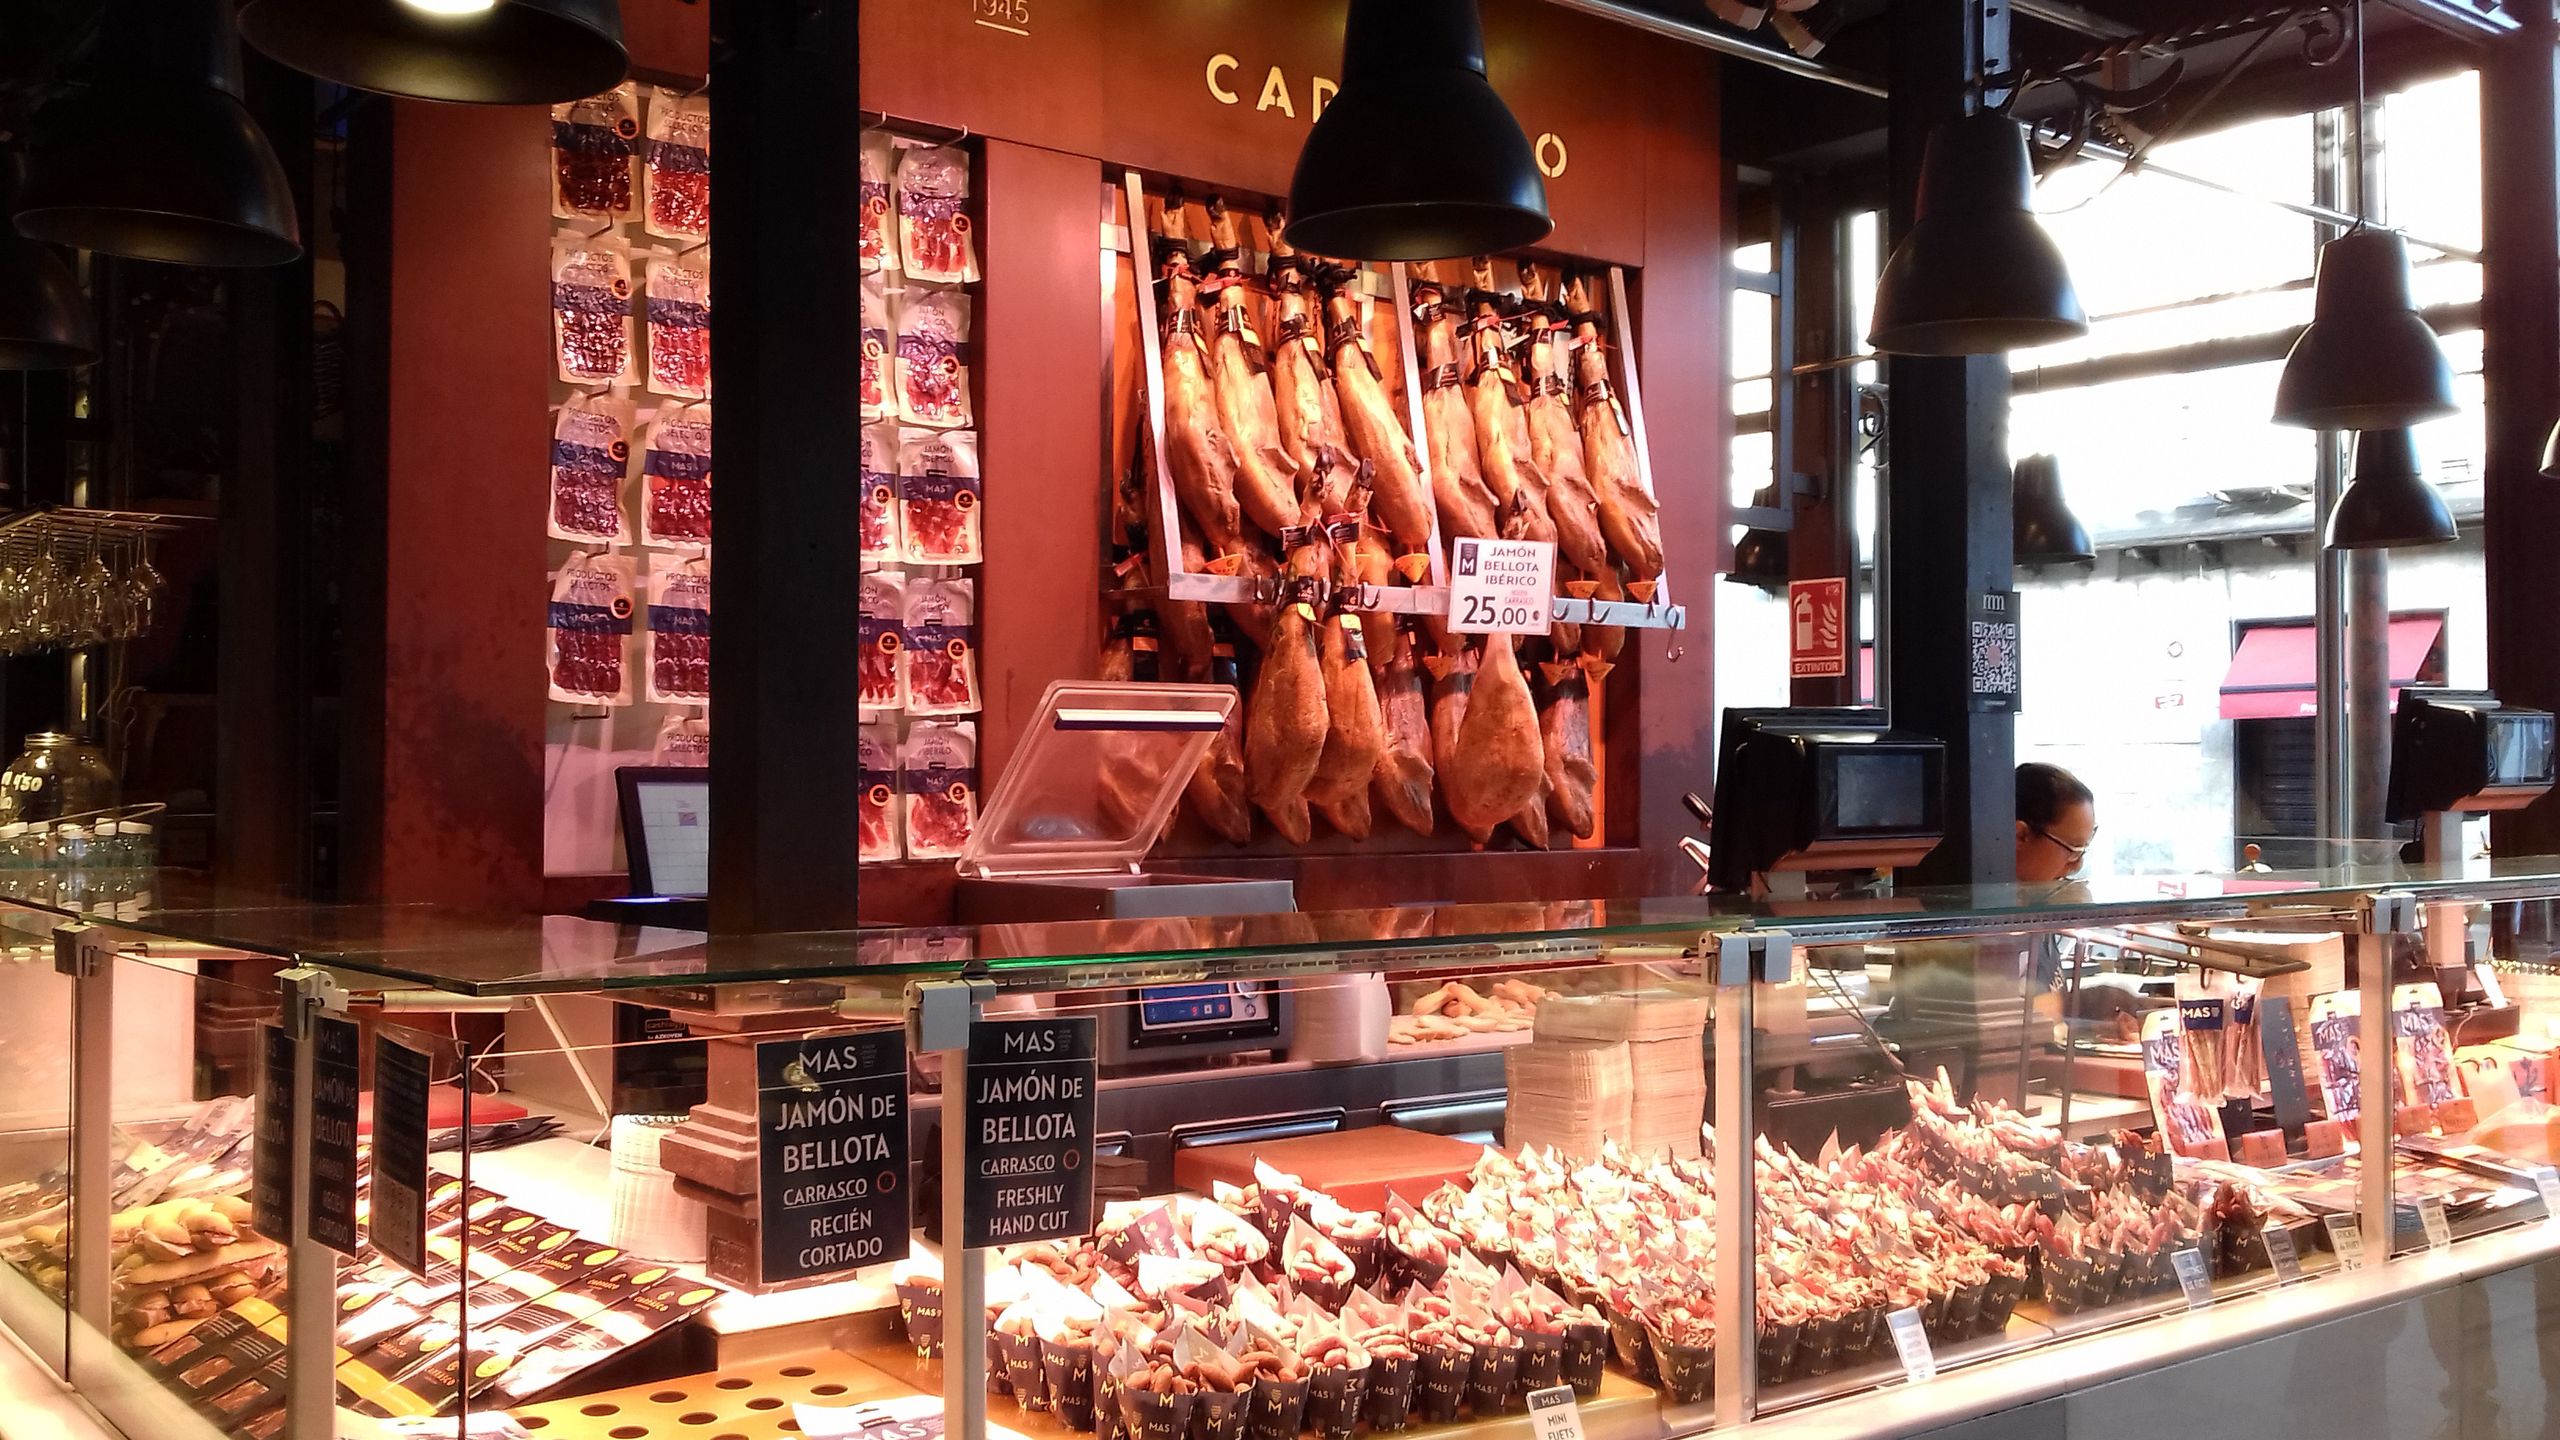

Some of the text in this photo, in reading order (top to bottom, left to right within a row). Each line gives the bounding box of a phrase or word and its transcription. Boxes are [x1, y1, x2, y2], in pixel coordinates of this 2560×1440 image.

[1490, 546, 1536, 557] JAMÓN
[1484, 561, 1539, 572] BELLOTA
[1486, 573, 1537, 586] IBÉRICO
[1461, 595, 1527, 627] 25,00
[859, 626, 869, 634] AS
[1795, 662, 1838, 672] EXTINTOR
[668, 733, 709, 743] PRODUCTO
[926, 777, 944, 785] MAS
[2181, 1008, 2211, 1018] MAS
[1004, 1029, 1056, 1053] MAS
[2318, 1024, 2342, 1045] MAS
[321, 1031, 342, 1053] MAS
[799, 1046, 858, 1074] MAS
[977, 1070, 1083, 1104] JAMÓN DE
[775, 1089, 897, 1131] JAMÓN DE
[982, 1112, 1076, 1144] BELLOTA
[783, 1133, 891, 1173] BELLOTA
[2145, 1151, 2156, 1160] M
[981, 1153, 1056, 1176] CARRASCO
[2138, 1167, 2153, 1176] MAS
[1982, 1179, 1993, 1190] M
[2041, 1173, 2052, 1183] M
[783, 1178, 868, 1206] CARRASCO
[997, 1185, 1064, 1208] FRESHLY
[810, 1208, 872, 1238] RECIÉN
[990, 1211, 1069, 1236] HAND CUT
[1115, 1231, 1129, 1248] M
[799, 1236, 883, 1269] CORTADO
[1343, 1245, 1362, 1254] MAS
[2093, 1265, 2106, 1276] M
[917, 1307, 936, 1317] MAS
[1853, 1322, 1864, 1333] M
[918, 1345, 931, 1360] M
[1412, 1341, 1432, 1354] MAS
[1010, 1360, 1028, 1369] MAS
[1047, 1352, 1065, 1366] MAS
[1385, 1359, 1398, 1373] M
[1440, 1357, 1455, 1372] M
[1483, 1359, 1498, 1373] M
[1532, 1353, 1546, 1367] M
[1578, 1352, 1591, 1366] M
[1073, 1368, 1086, 1382] M
[1676, 1365, 1690, 1376] M
[1429, 1382, 1448, 1393] MAS
[1522, 1377, 1541, 1388] MAS
[1375, 1385, 1395, 1396] MAS
[1061, 1395, 1081, 1405] MAS
[1159, 1393, 1174, 1408] M
[1541, 1394, 1561, 1406] MAS
[1268, 1401, 1282, 1415] M
[1207, 1418, 1222, 1432] M
[1547, 1412, 1567, 1426] MINI
[1149, 1422, 1170, 1433] MAS
[1548, 1428, 1575, 1440] FUETS
